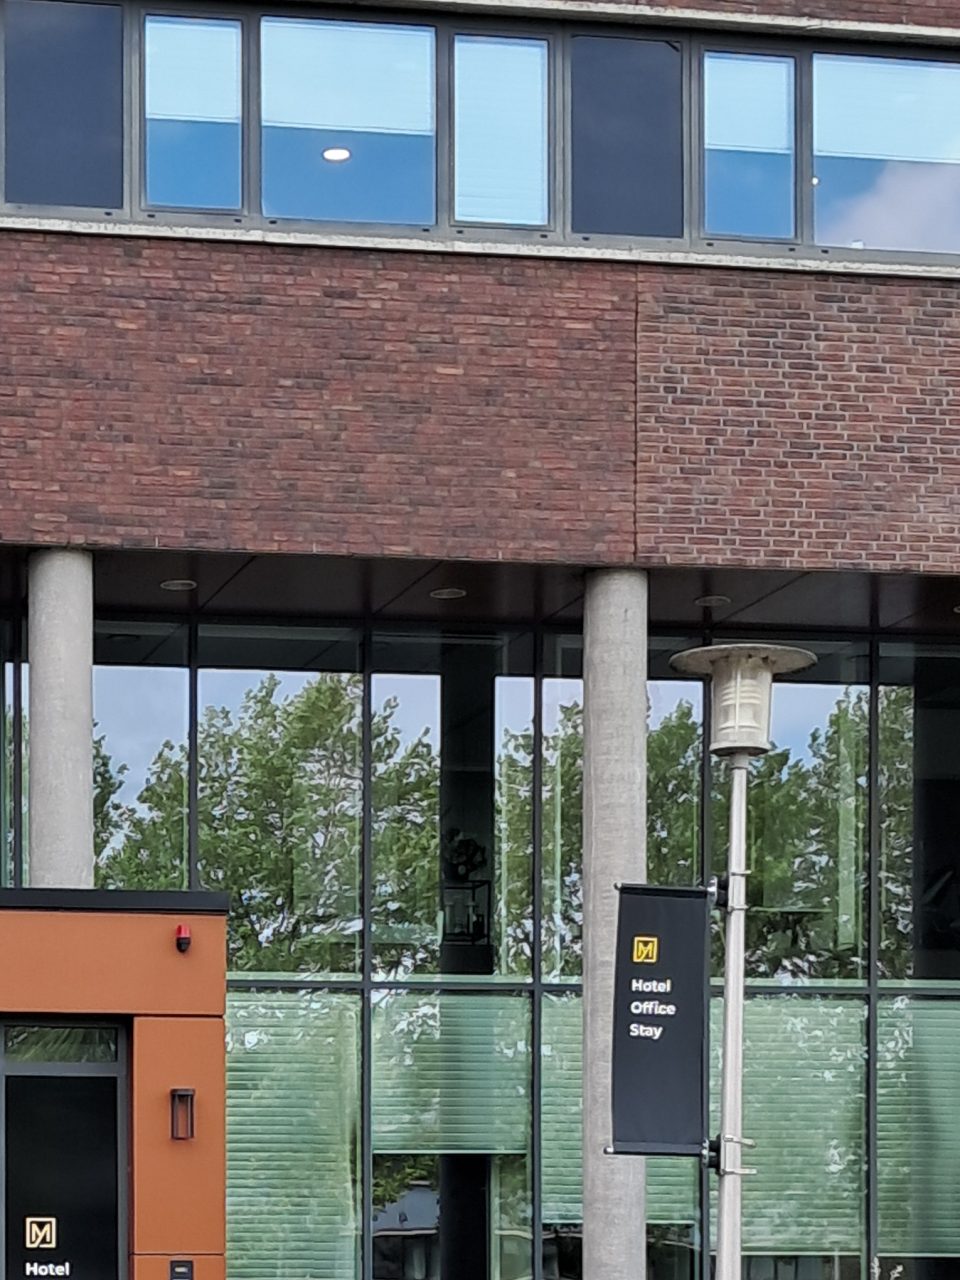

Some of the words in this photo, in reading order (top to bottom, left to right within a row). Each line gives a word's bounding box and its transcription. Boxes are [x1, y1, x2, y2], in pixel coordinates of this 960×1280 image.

[631, 979, 671, 992] Hotel
[630, 1001, 676, 1015] Office
[629, 1023, 663, 1039] Stay
[25, 1262, 70, 1276] Hotel
